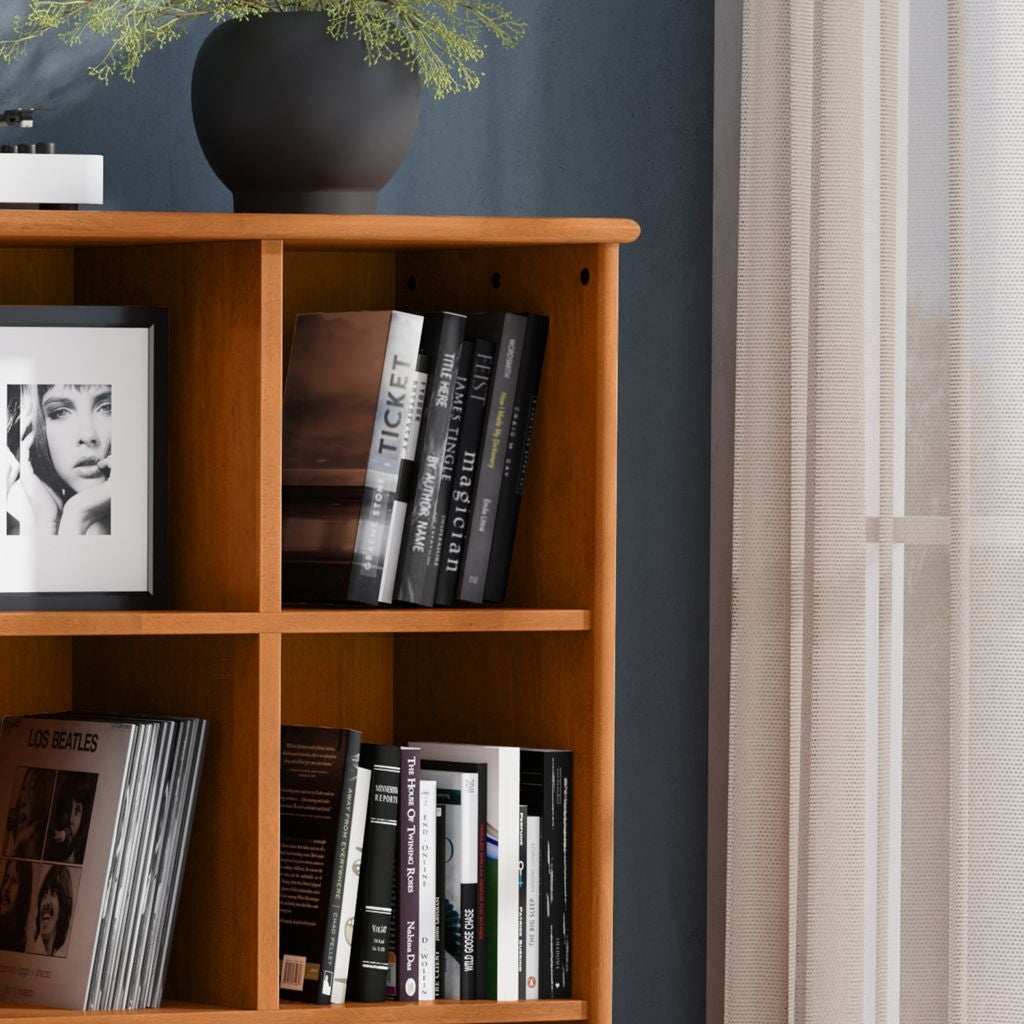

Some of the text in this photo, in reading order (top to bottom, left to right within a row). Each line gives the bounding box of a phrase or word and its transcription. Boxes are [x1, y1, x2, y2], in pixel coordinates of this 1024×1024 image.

[470, 353, 493, 407] FEIST
[378, 354, 411, 455] TICKET
[441, 375, 467, 482] JAMES TINGLE
[419, 473, 436, 515] AUTHOR
[446, 450, 477, 572] magician
[412, 520, 429, 553] NAME
[28, 729, 99, 753] LOS BEATLES
[407, 756, 417, 776] THE
[407, 778, 417, 805] HOUSE
[407, 824, 417, 866] TWINING
[406, 867, 416, 893] ROSES
[464, 908, 474, 972] WILD GOOSE CHASE
